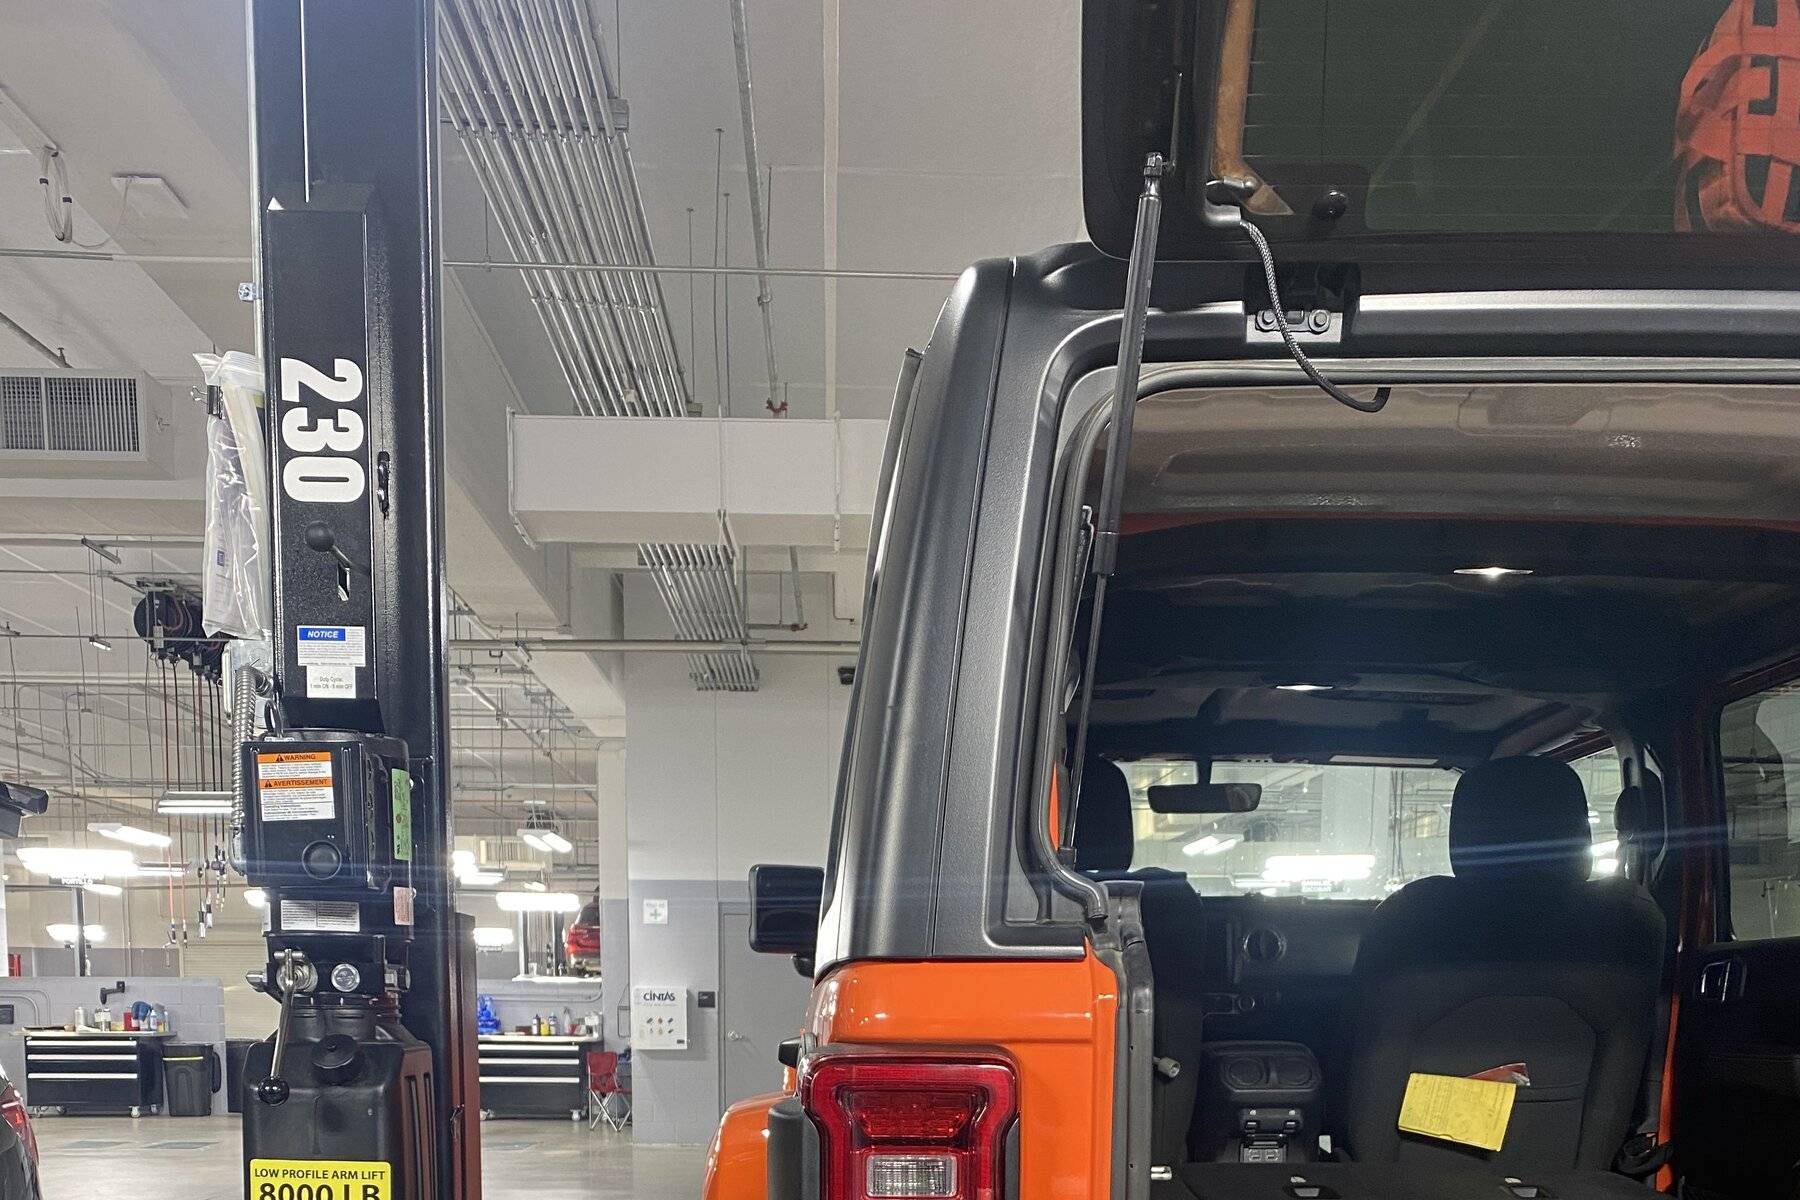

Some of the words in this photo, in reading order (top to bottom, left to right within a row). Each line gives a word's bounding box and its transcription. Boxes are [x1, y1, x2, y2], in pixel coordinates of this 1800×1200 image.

[281, 357, 365, 502] 230
[307, 630, 339, 639] NOTICE
[274, 779, 328, 787] AVERTISSEMENT
[643, 989, 675, 1001] CINTAS
[255, 1168, 279, 1178] LOW
[282, 1169, 329, 1179] PROFILE
[331, 1170, 358, 1180] ARM
[361, 1170, 385, 1180] LIFT
